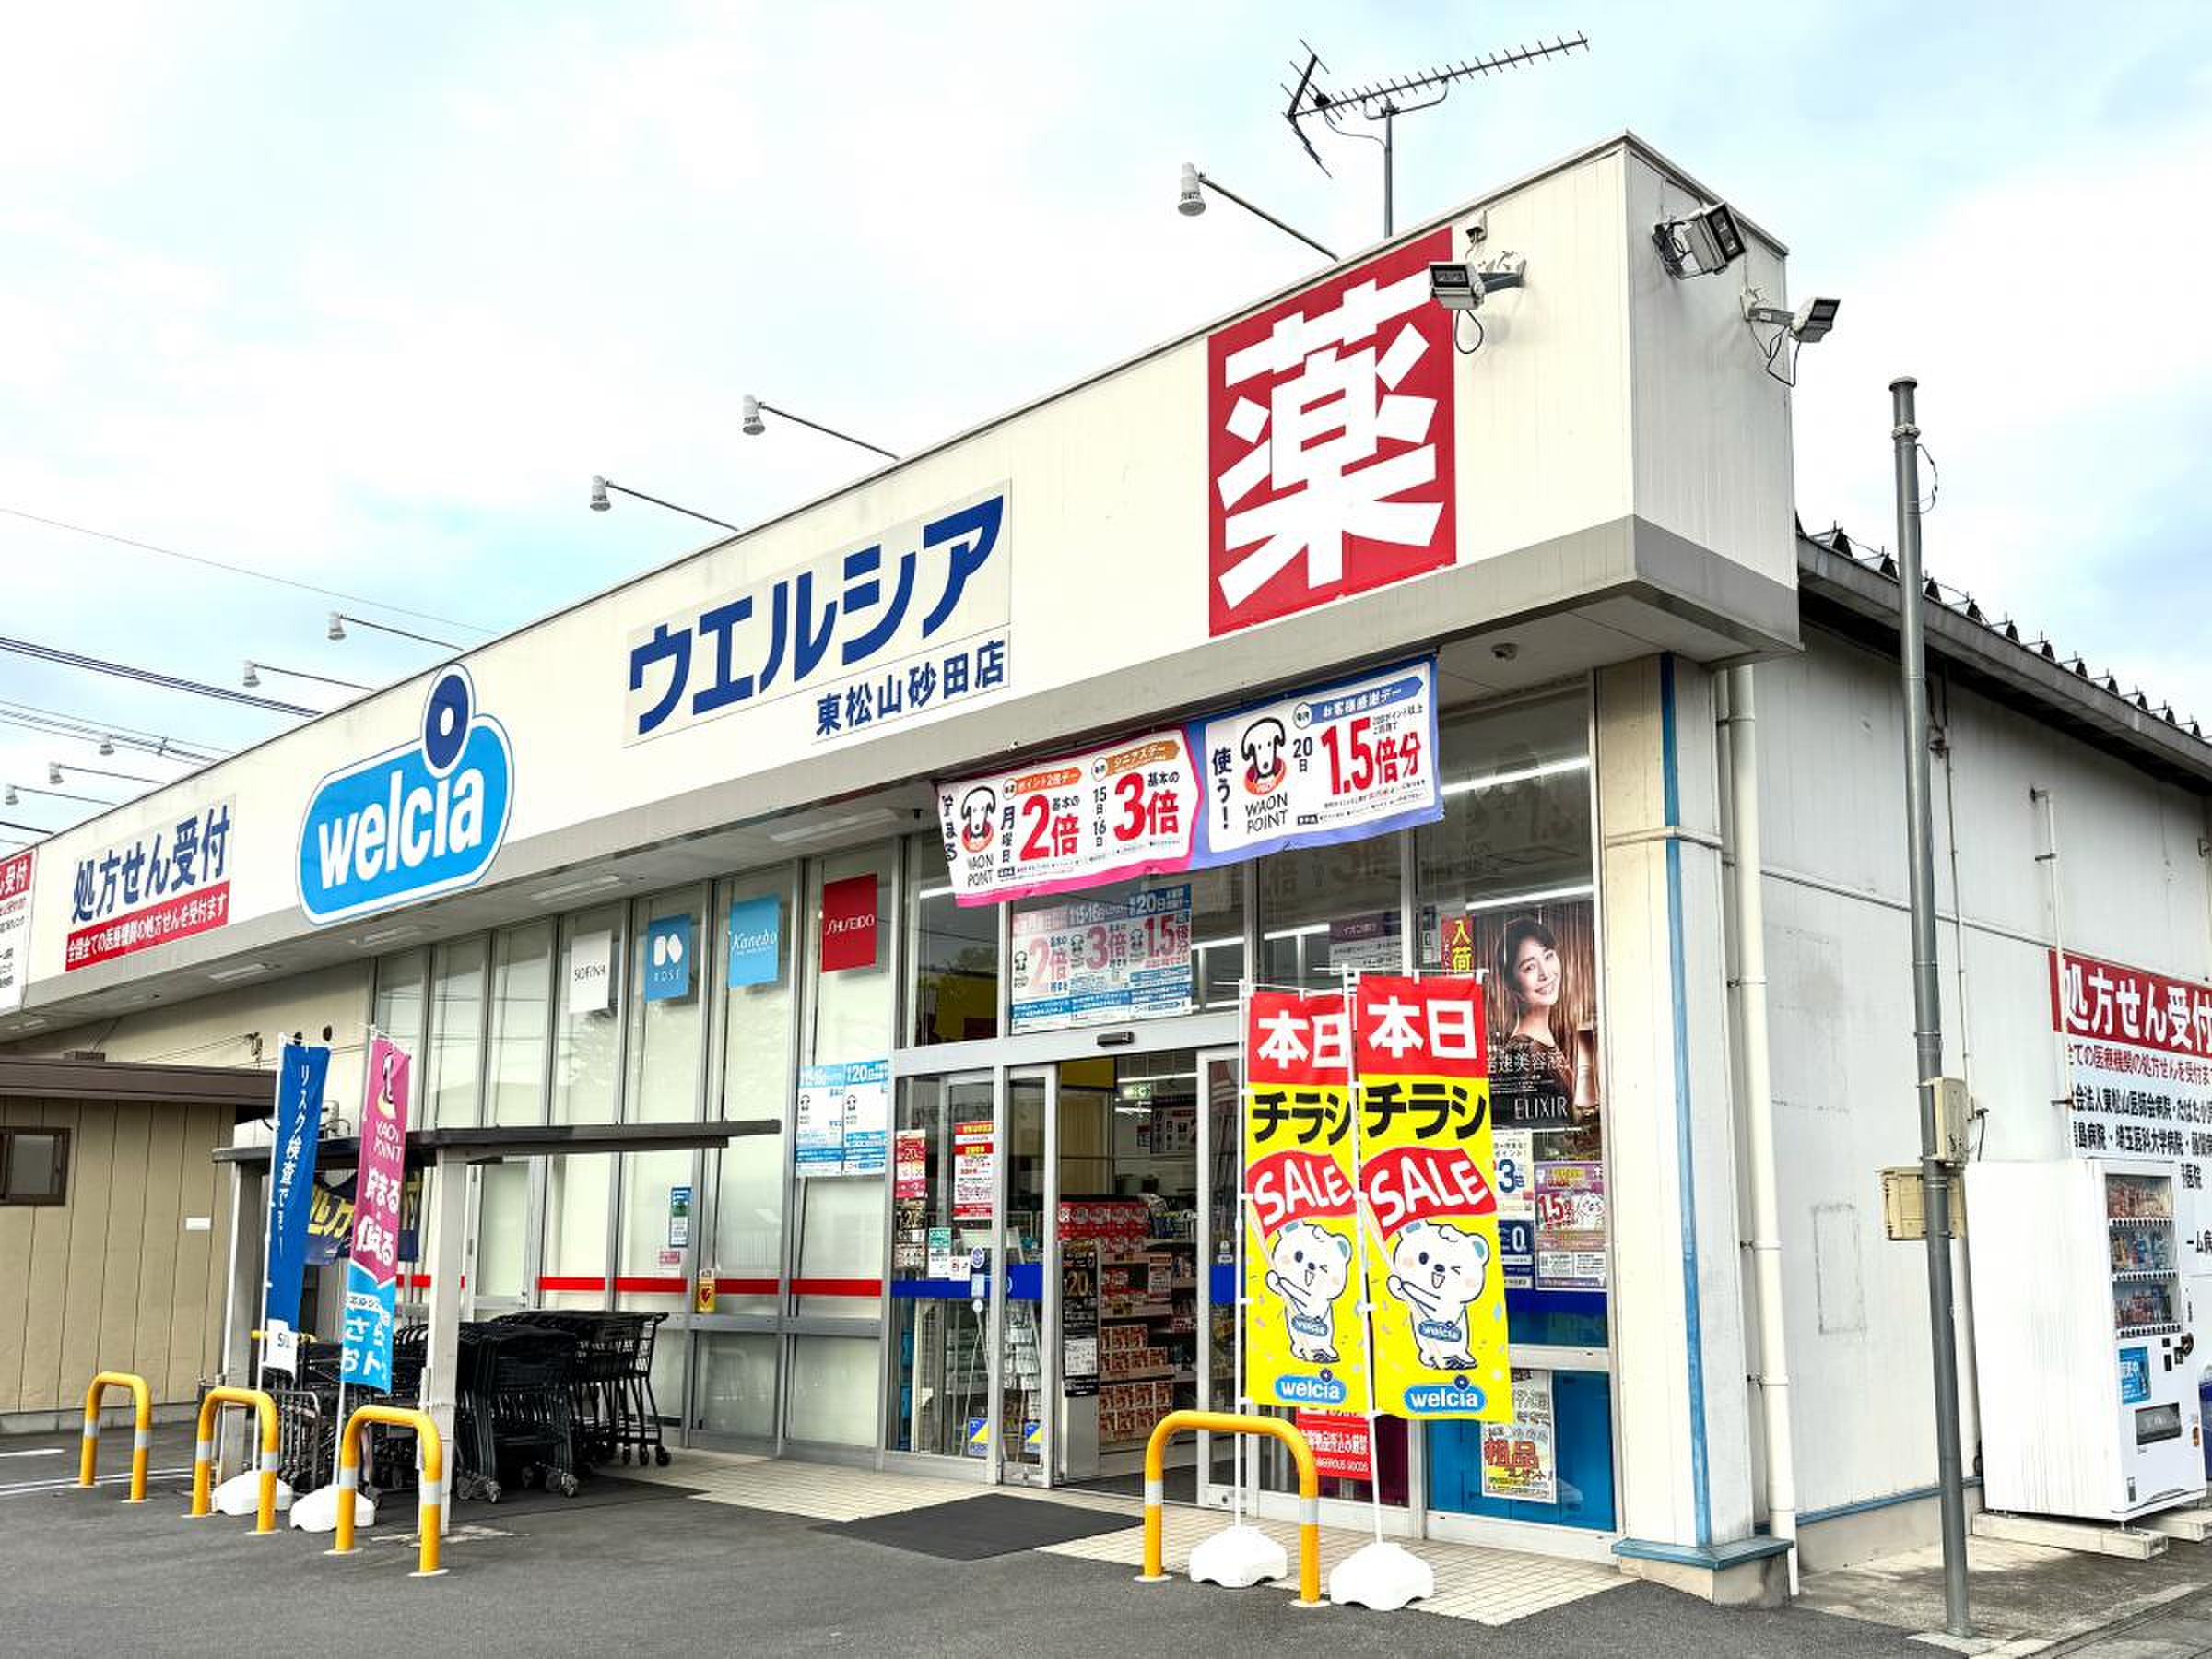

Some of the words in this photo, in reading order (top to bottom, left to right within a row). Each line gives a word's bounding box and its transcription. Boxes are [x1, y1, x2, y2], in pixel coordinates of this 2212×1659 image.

[1216, 267, 1445, 612] 薬
[629, 494, 1004, 735] ウエルシア
[816, 640, 1006, 737] 東松山砂田店
[318, 766, 485, 891] welcia
[1244, 791, 1288, 818] WAON
[1246, 809, 1288, 834] POINT
[72, 804, 231, 924] 処方せん受付
[732, 927, 777, 950] Kanebo
[1256, 1009, 1348, 1069] 本日
[1366, 995, 1477, 1059] 本日
[1253, 1090, 1350, 1146] チラシ
[1365, 1083, 1487, 1140] チラシ
[1514, 1096, 1568, 1121] ELIXIR
[1253, 1159, 1353, 1226] SALE
[1370, 1155, 1488, 1228] SALE
[1280, 1381, 1341, 1400] welcia
[1409, 1387, 1479, 1408] welcia
